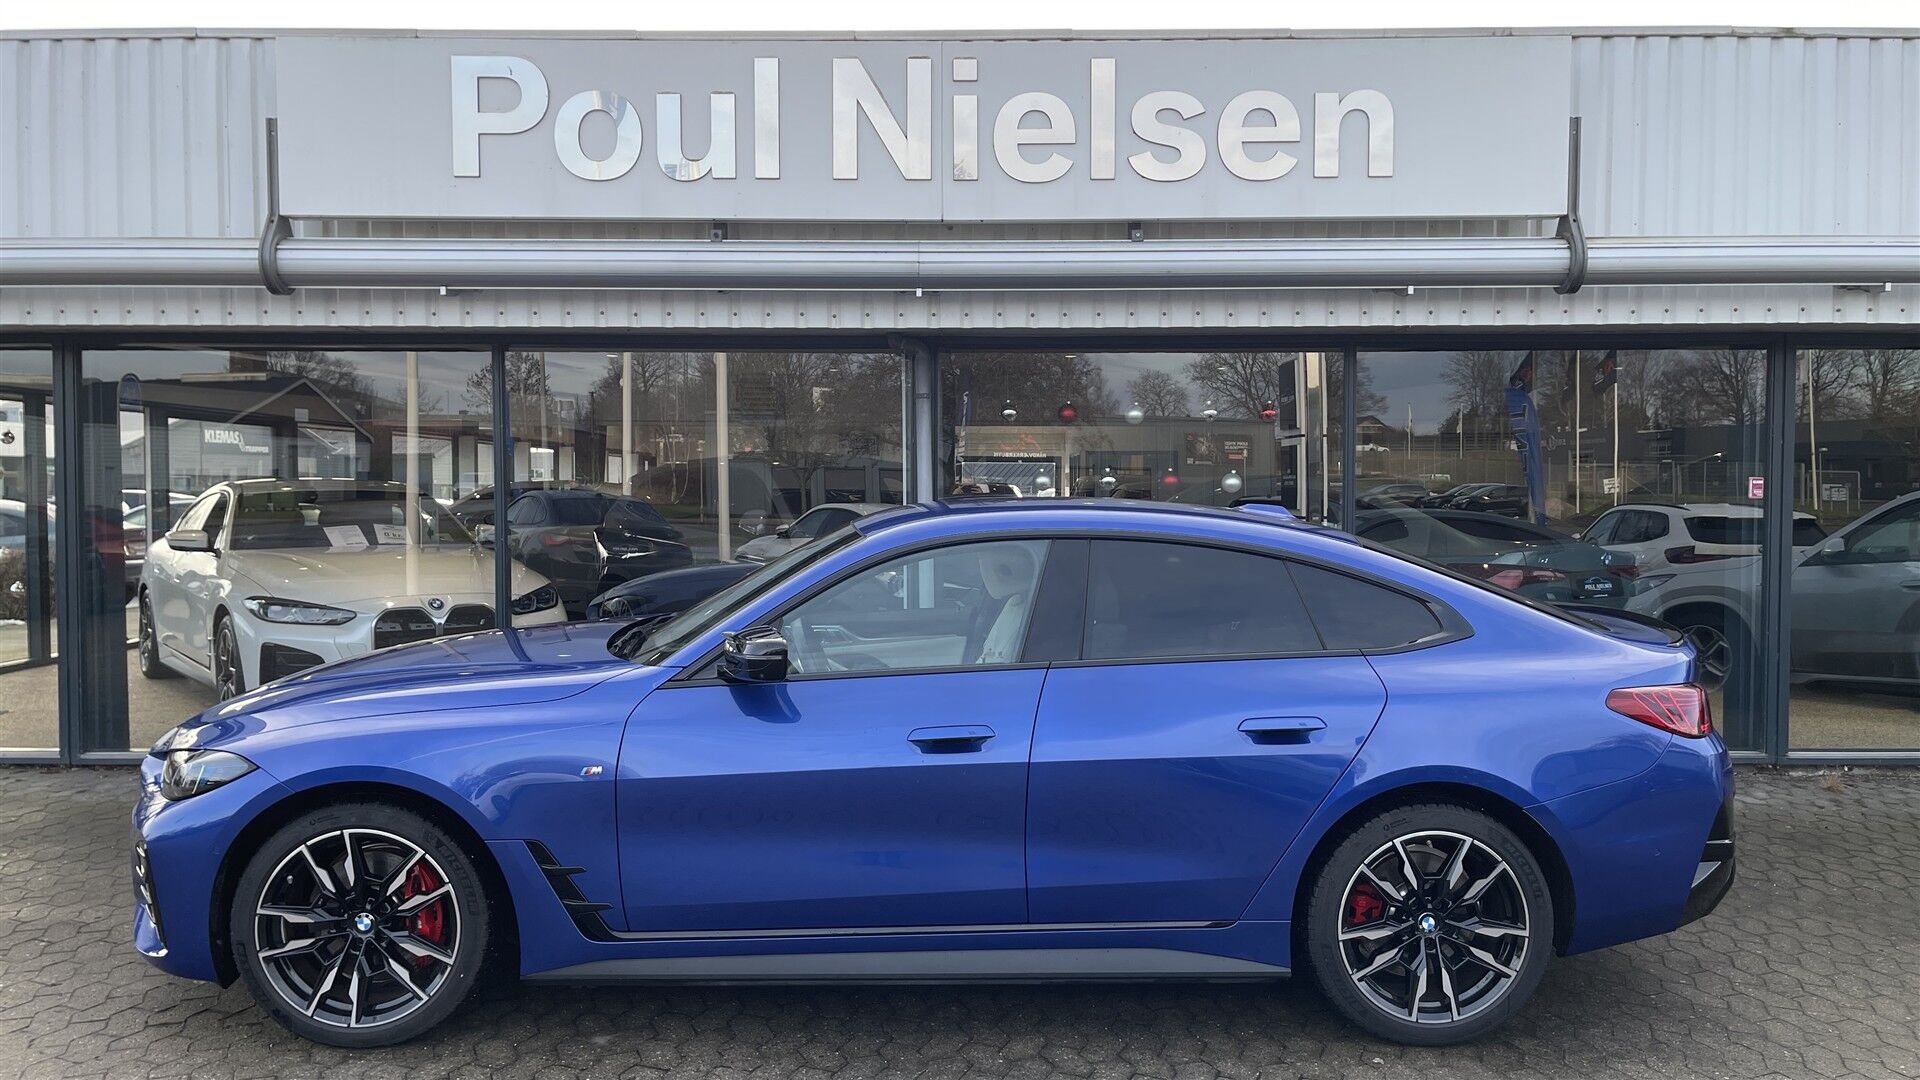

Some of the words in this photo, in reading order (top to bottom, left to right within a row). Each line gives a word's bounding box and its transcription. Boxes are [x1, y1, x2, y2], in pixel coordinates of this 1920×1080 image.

[450, 55, 781, 182] Poul
[832, 56, 1395, 182] Nielsen
[204, 429, 240, 444] KLEMAS
